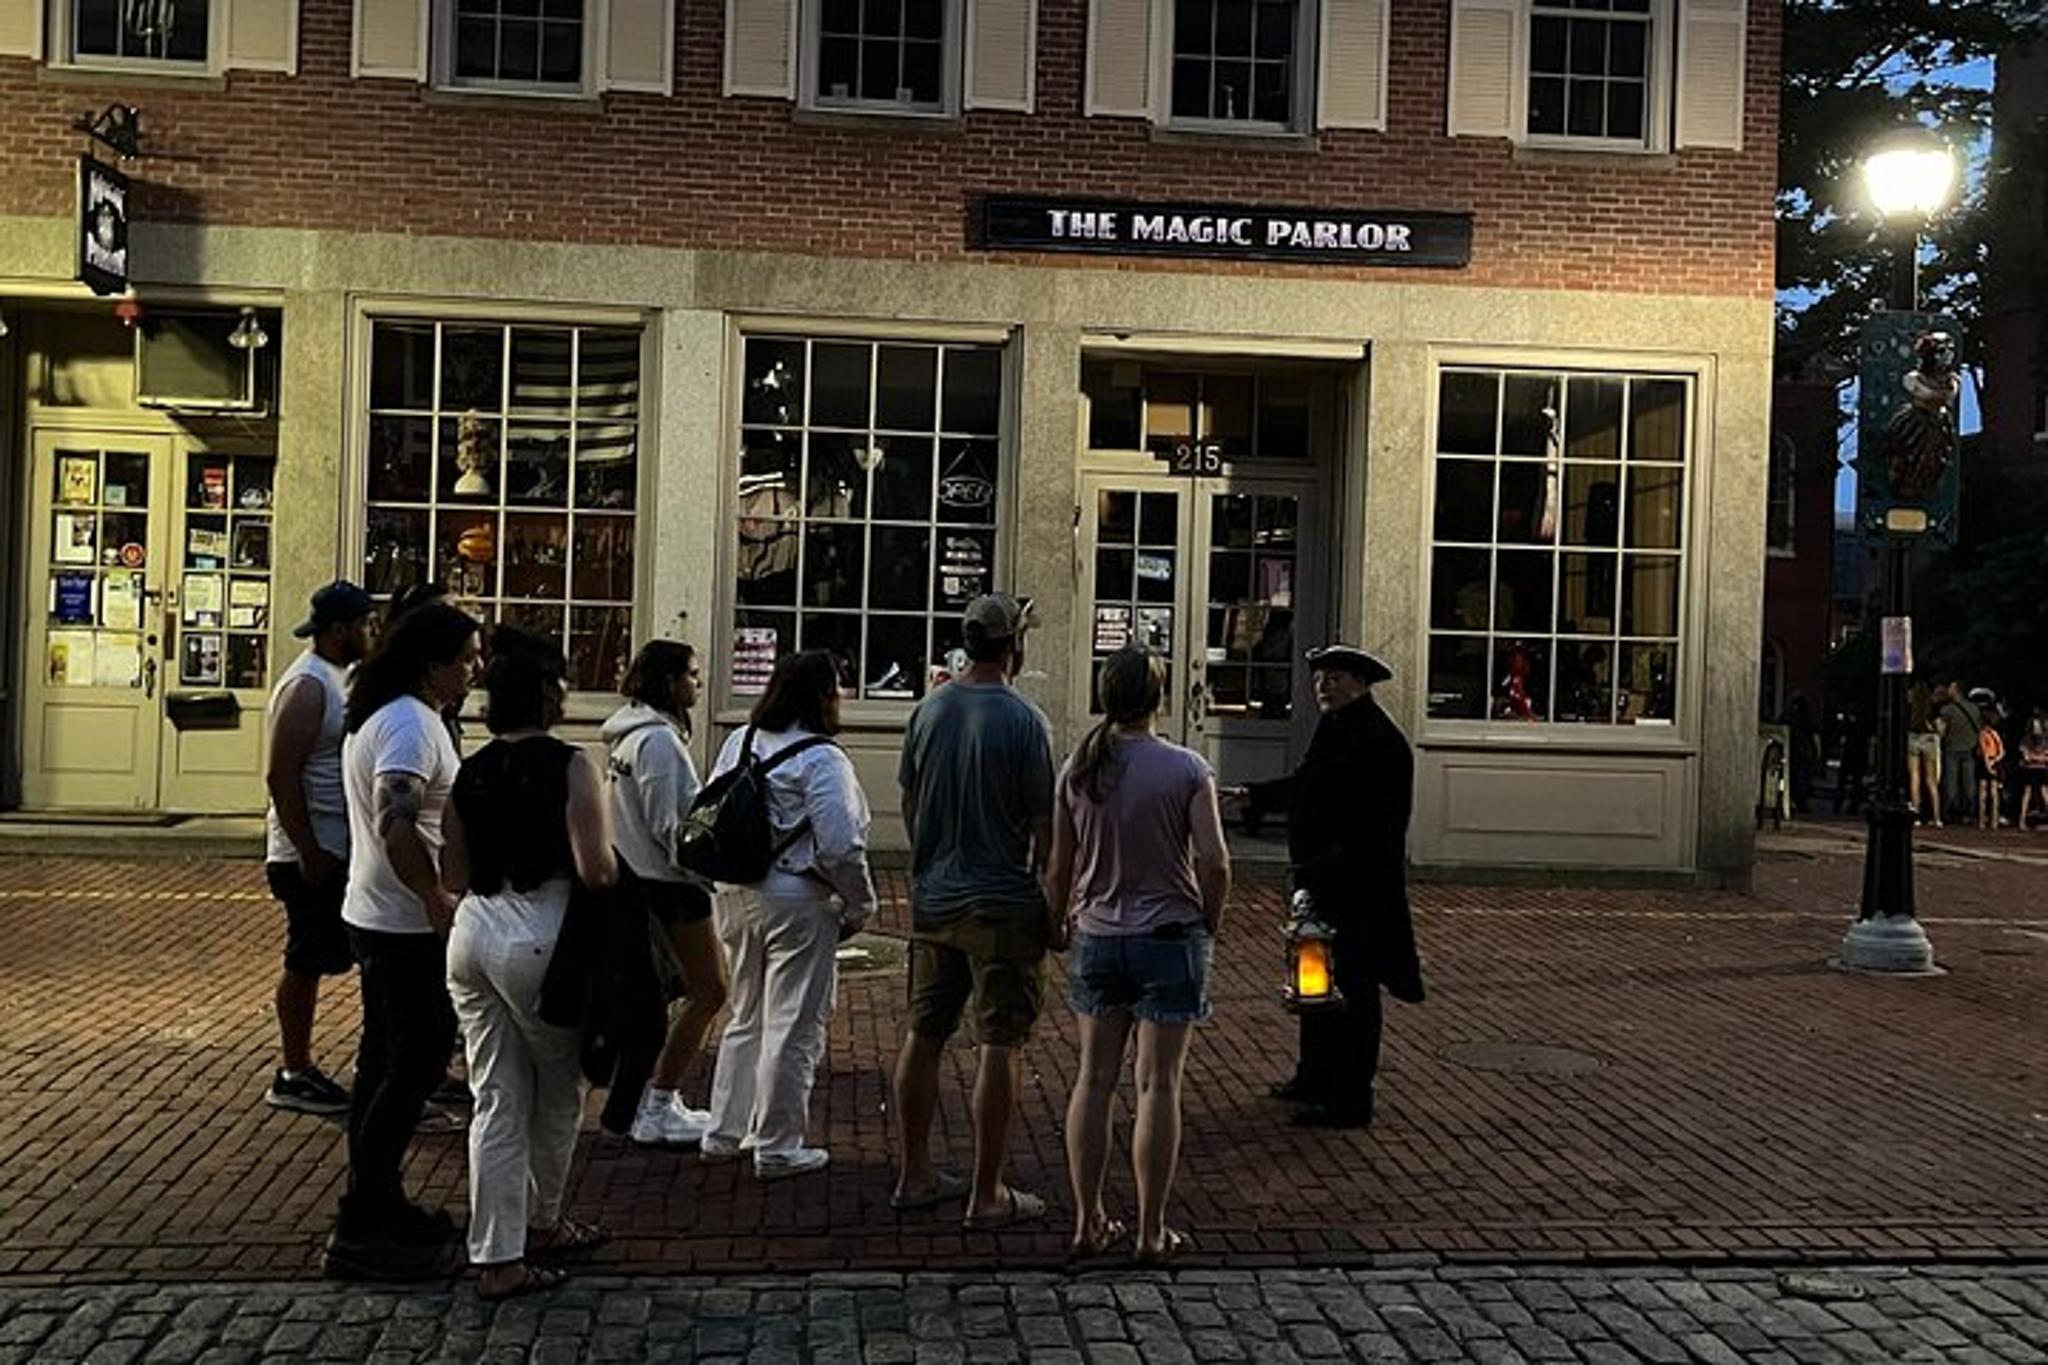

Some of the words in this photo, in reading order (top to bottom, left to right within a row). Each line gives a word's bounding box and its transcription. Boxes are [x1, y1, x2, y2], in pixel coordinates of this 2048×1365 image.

[1048, 210, 1117, 240] THE
[1131, 214, 1253, 246] MAGIC
[1266, 221, 1411, 251] PARLOR
[1176, 443, 1221, 470] 215
